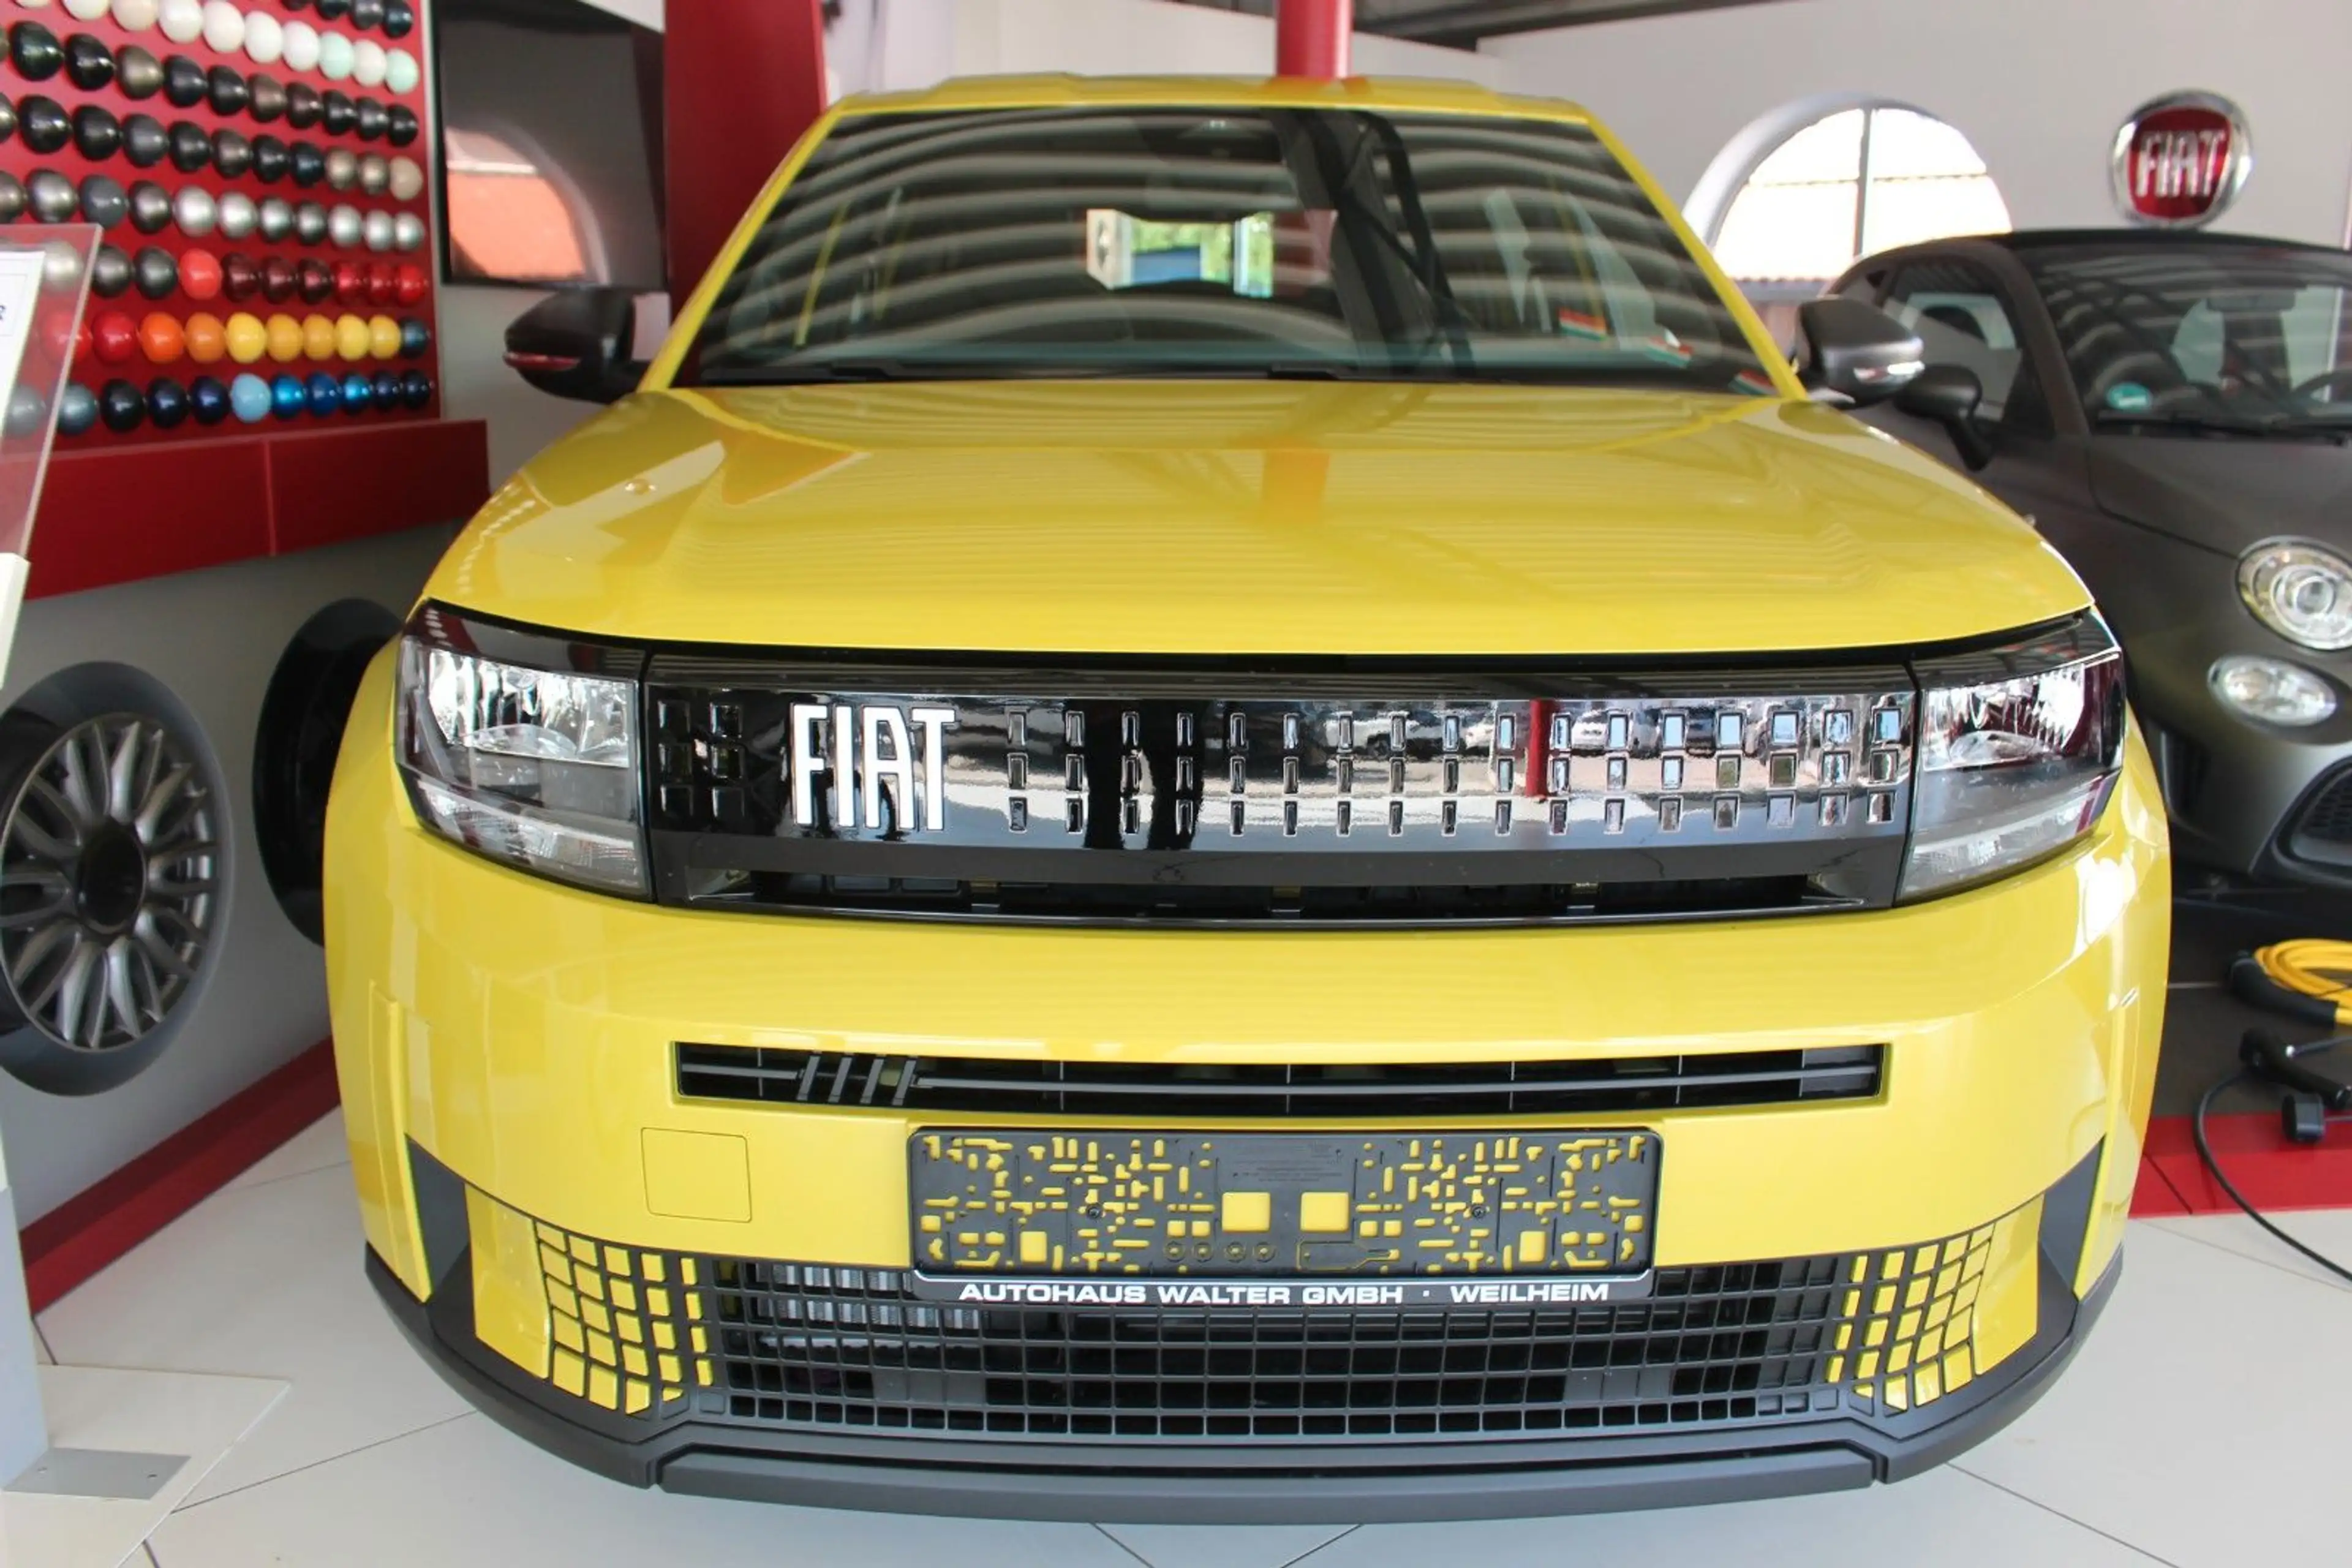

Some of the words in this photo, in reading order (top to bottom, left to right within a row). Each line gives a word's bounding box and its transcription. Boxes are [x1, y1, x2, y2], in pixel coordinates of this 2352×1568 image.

[2135, 129, 2226, 197] FIAT
[791, 704, 956, 831] FIAT
[959, 1284, 1147, 1303] AUTOHAUS
[1157, 1286, 1291, 1305] WALTER
[1302, 1286, 1403, 1305] GMBH
[1450, 1283, 1610, 1303] WEILHEIM
